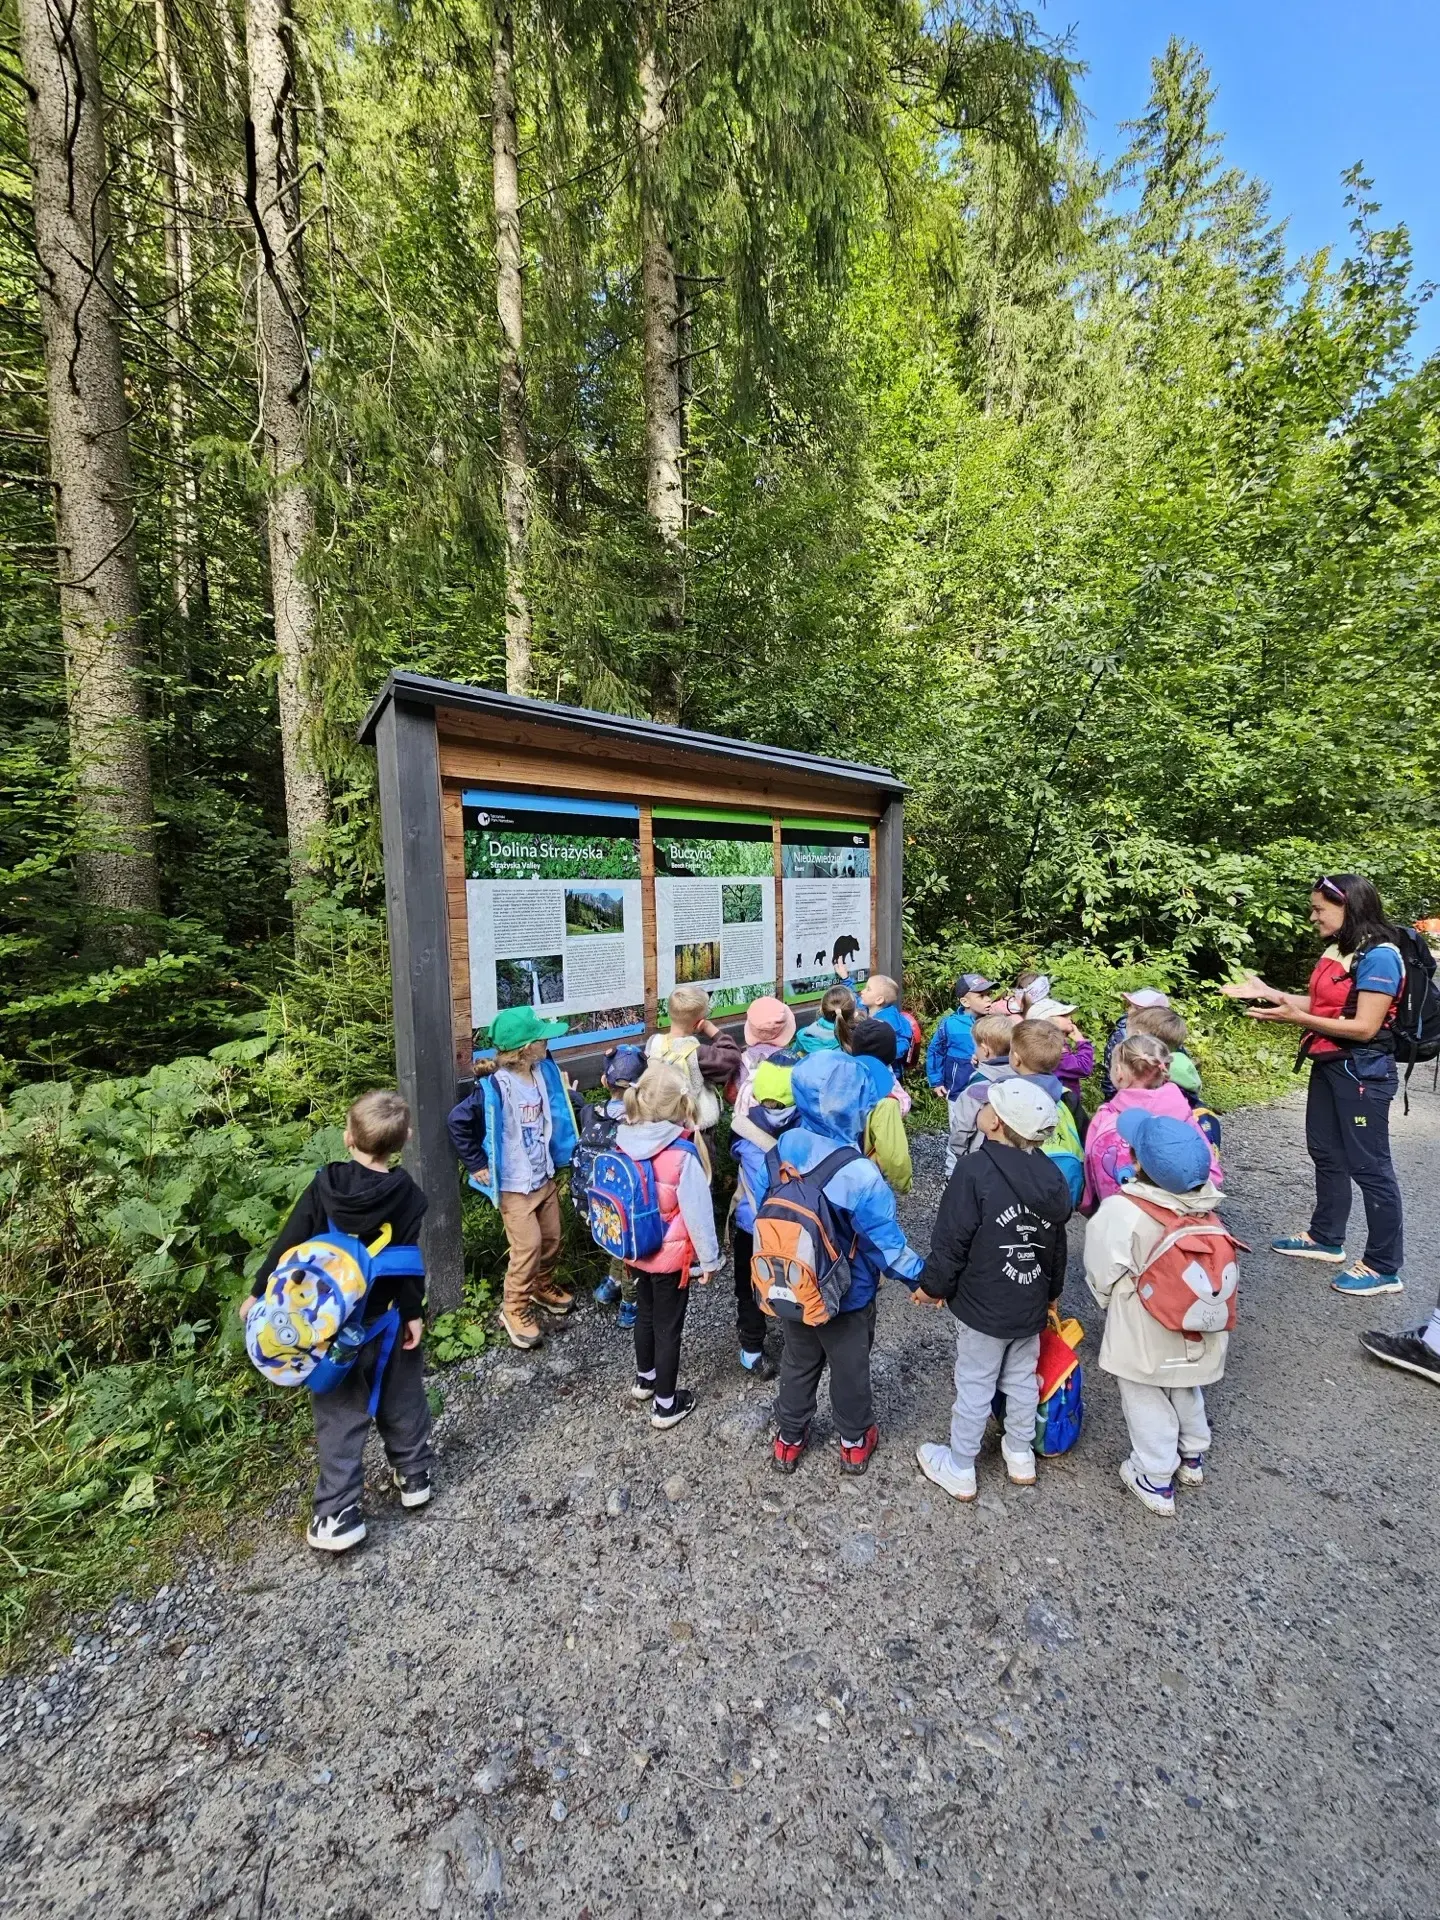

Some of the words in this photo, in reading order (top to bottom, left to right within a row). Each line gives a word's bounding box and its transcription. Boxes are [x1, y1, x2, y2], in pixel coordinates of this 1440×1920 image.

[489, 840, 538, 858] Dolina
[540, 843, 603, 862] Strążyska
[670, 845, 712, 861] Buczyna
[490, 861, 521, 870] Strążyska
[521, 861, 541, 871] Valley
[995, 1205, 1018, 1228] TAKE
[1001, 1261, 1018, 1281] THE
[1018, 1271, 1032, 1285] WILD
